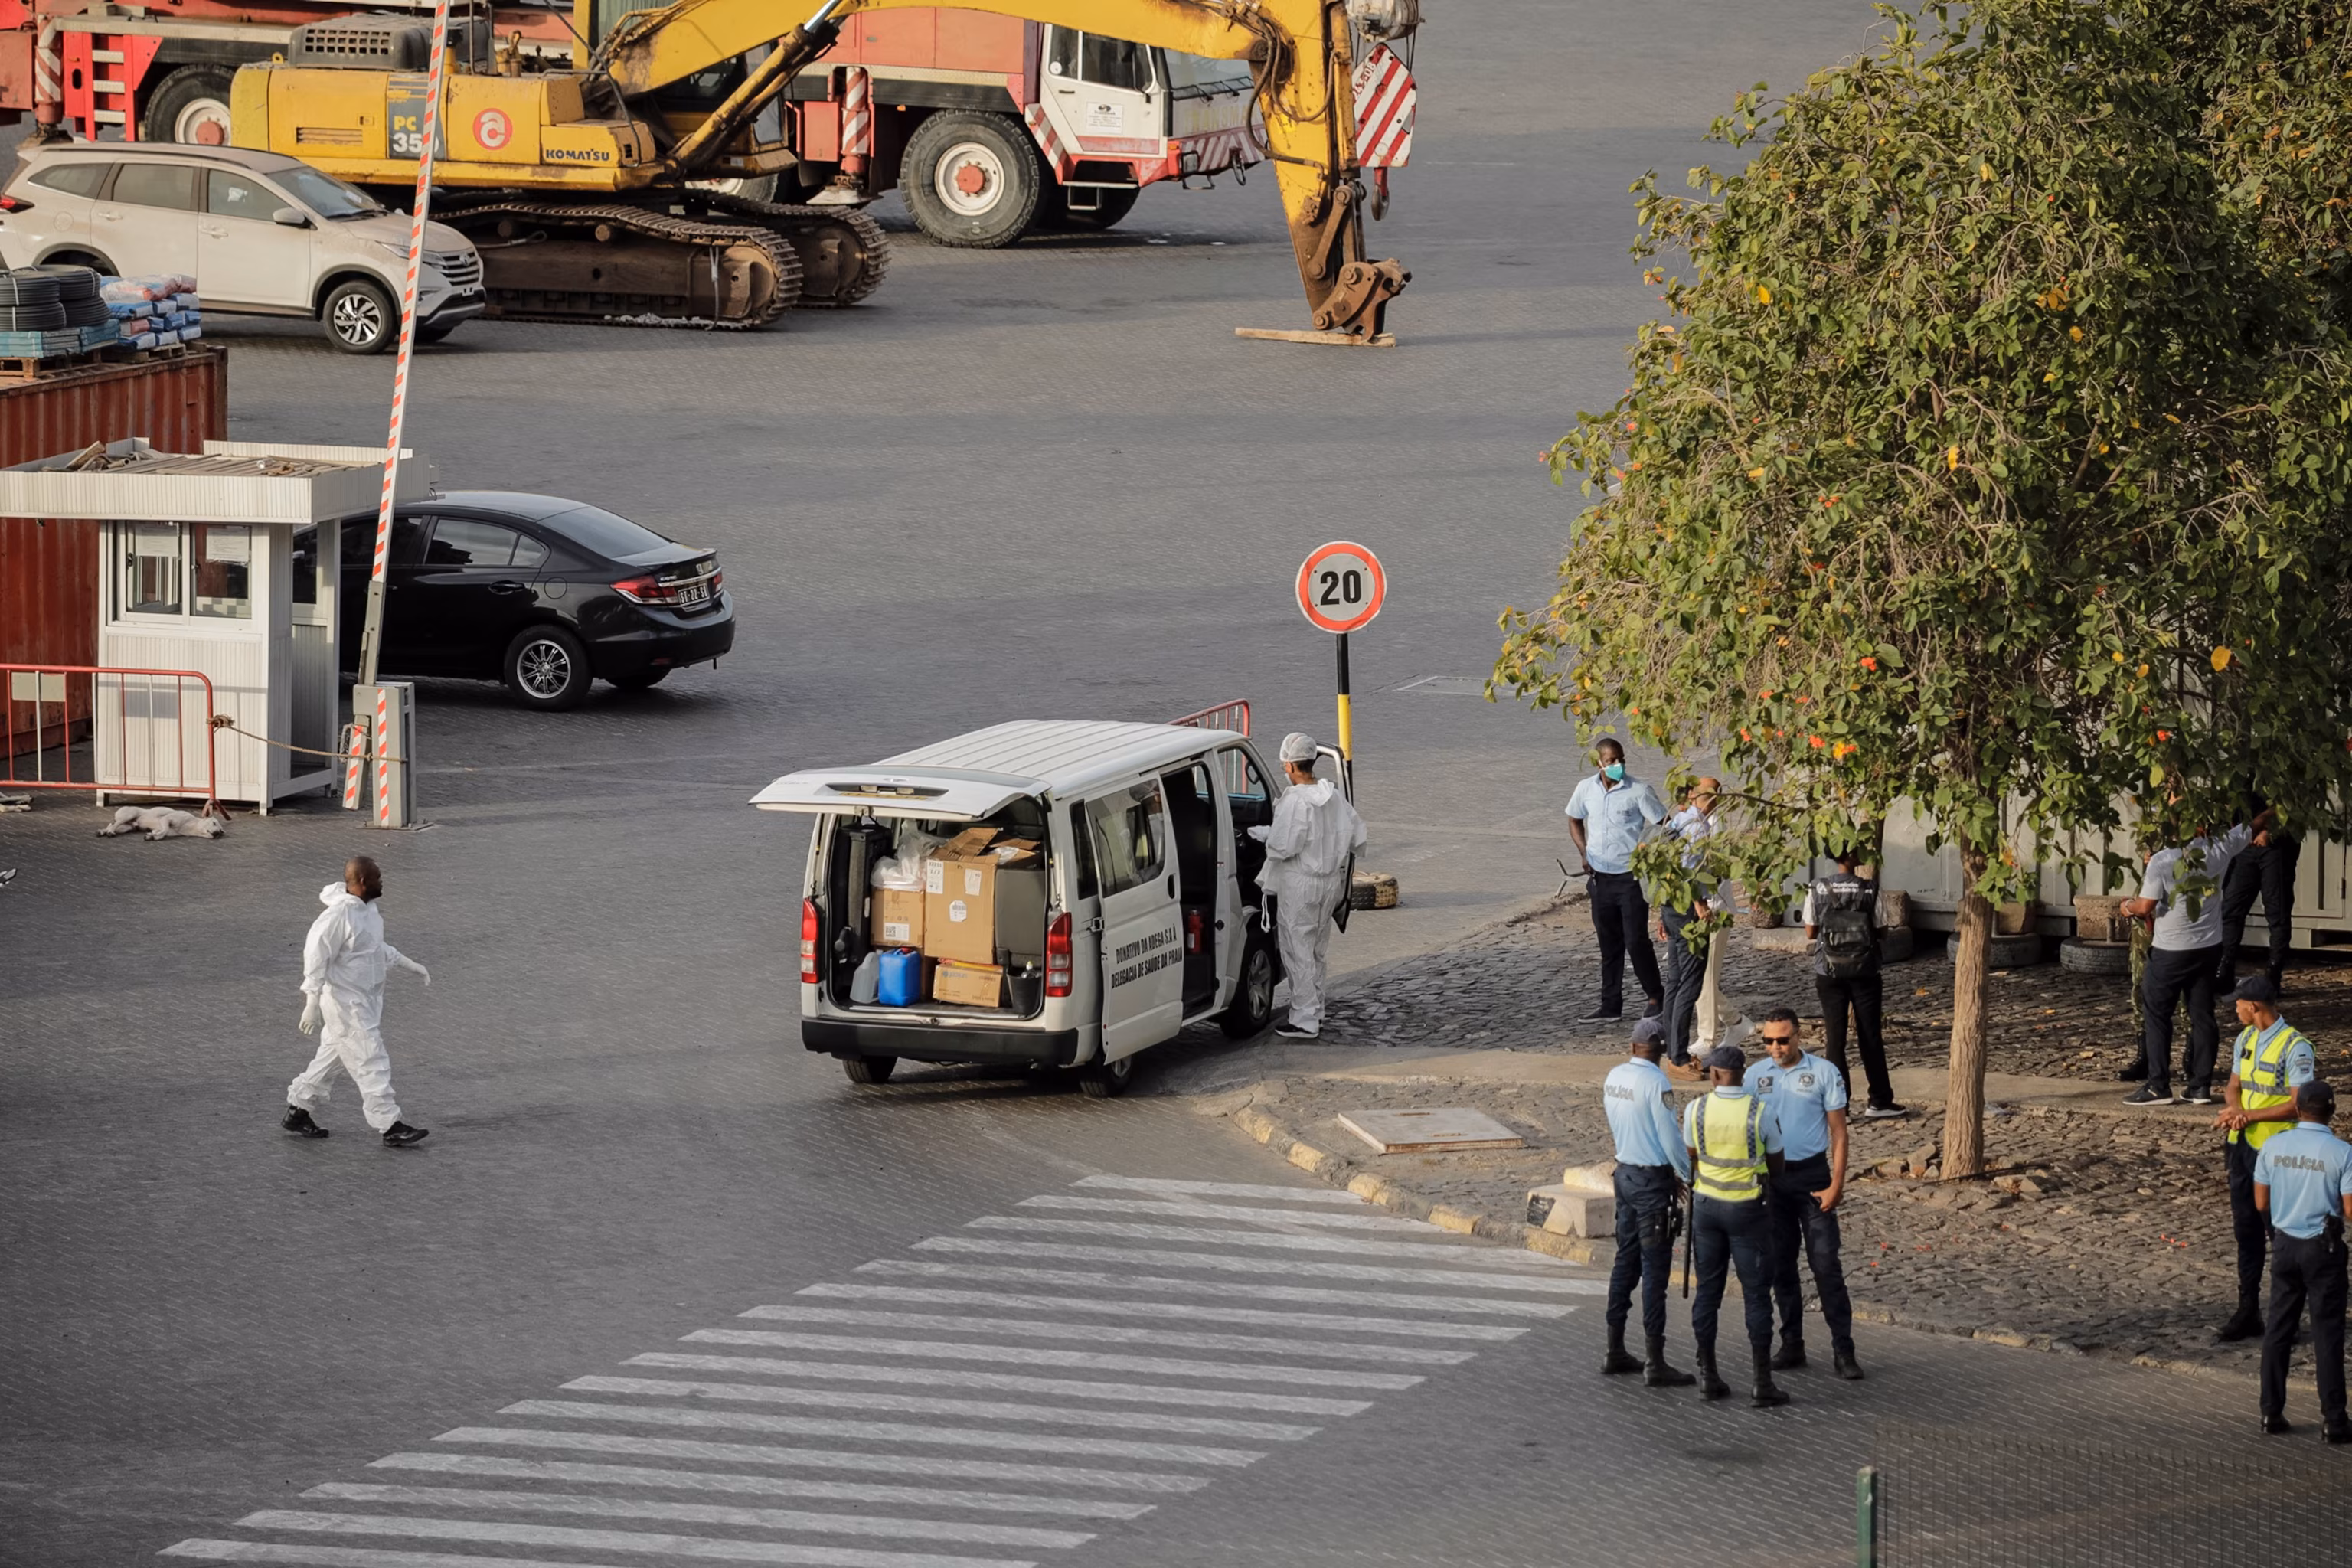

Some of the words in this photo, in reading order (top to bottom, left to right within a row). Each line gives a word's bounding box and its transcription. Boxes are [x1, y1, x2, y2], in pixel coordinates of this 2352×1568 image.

[394, 116, 416, 131] PC
[392, 133, 440, 152] 35
[546, 149, 610, 161] KOMATSU
[1320, 570, 1361, 606] 20
[1116, 940, 1141, 964] DONATIVO
[1141, 937, 1148, 955] DA
[1148, 931, 1165, 951] ADEGA
[1112, 964, 1138, 989] DELEGACIA
[1138, 962, 1145, 978] DE
[1161, 952, 1168, 969] DA
[1168, 946, 1183, 966] PRAIA
[2274, 1155, 2326, 1173] POLÍCIA
